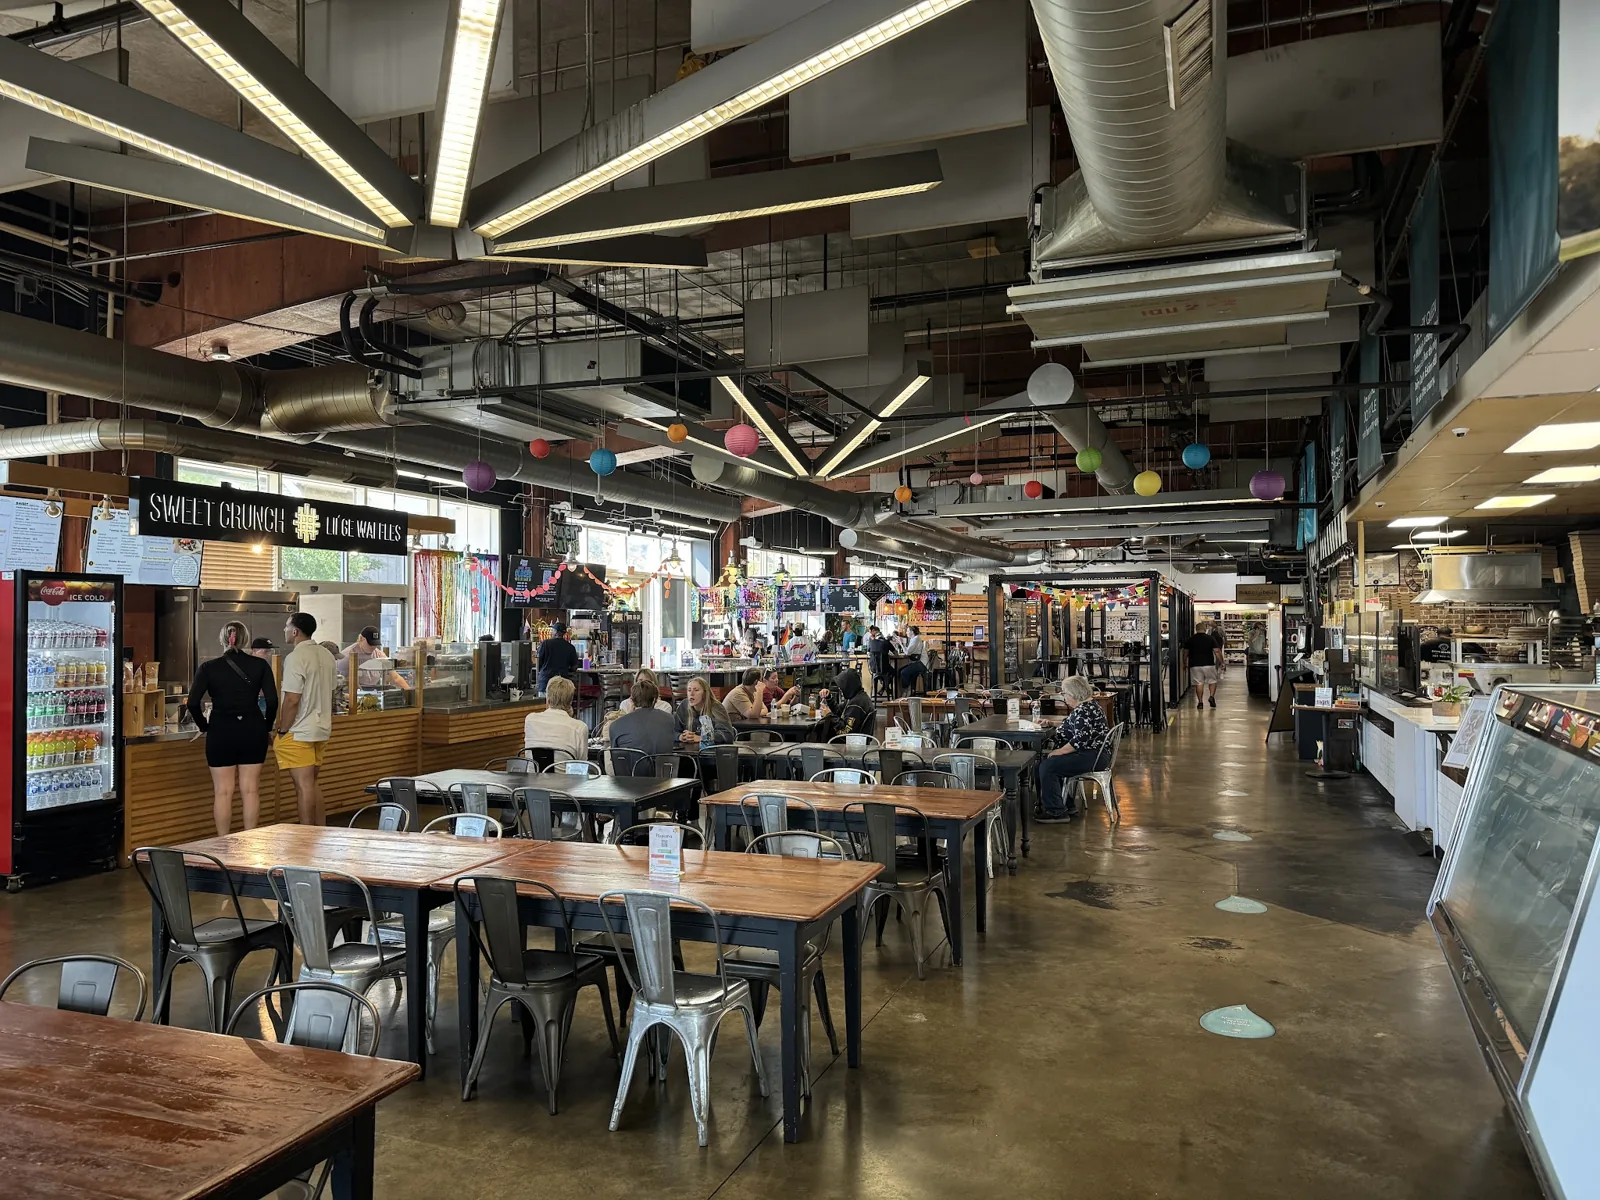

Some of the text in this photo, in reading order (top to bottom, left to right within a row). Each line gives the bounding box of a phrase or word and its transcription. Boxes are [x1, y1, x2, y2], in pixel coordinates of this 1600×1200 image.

[149, 492, 285, 533] SWEET CRUNCH
[356, 520, 402, 542] WAFFLES
[84, 594, 105, 602] COLD
